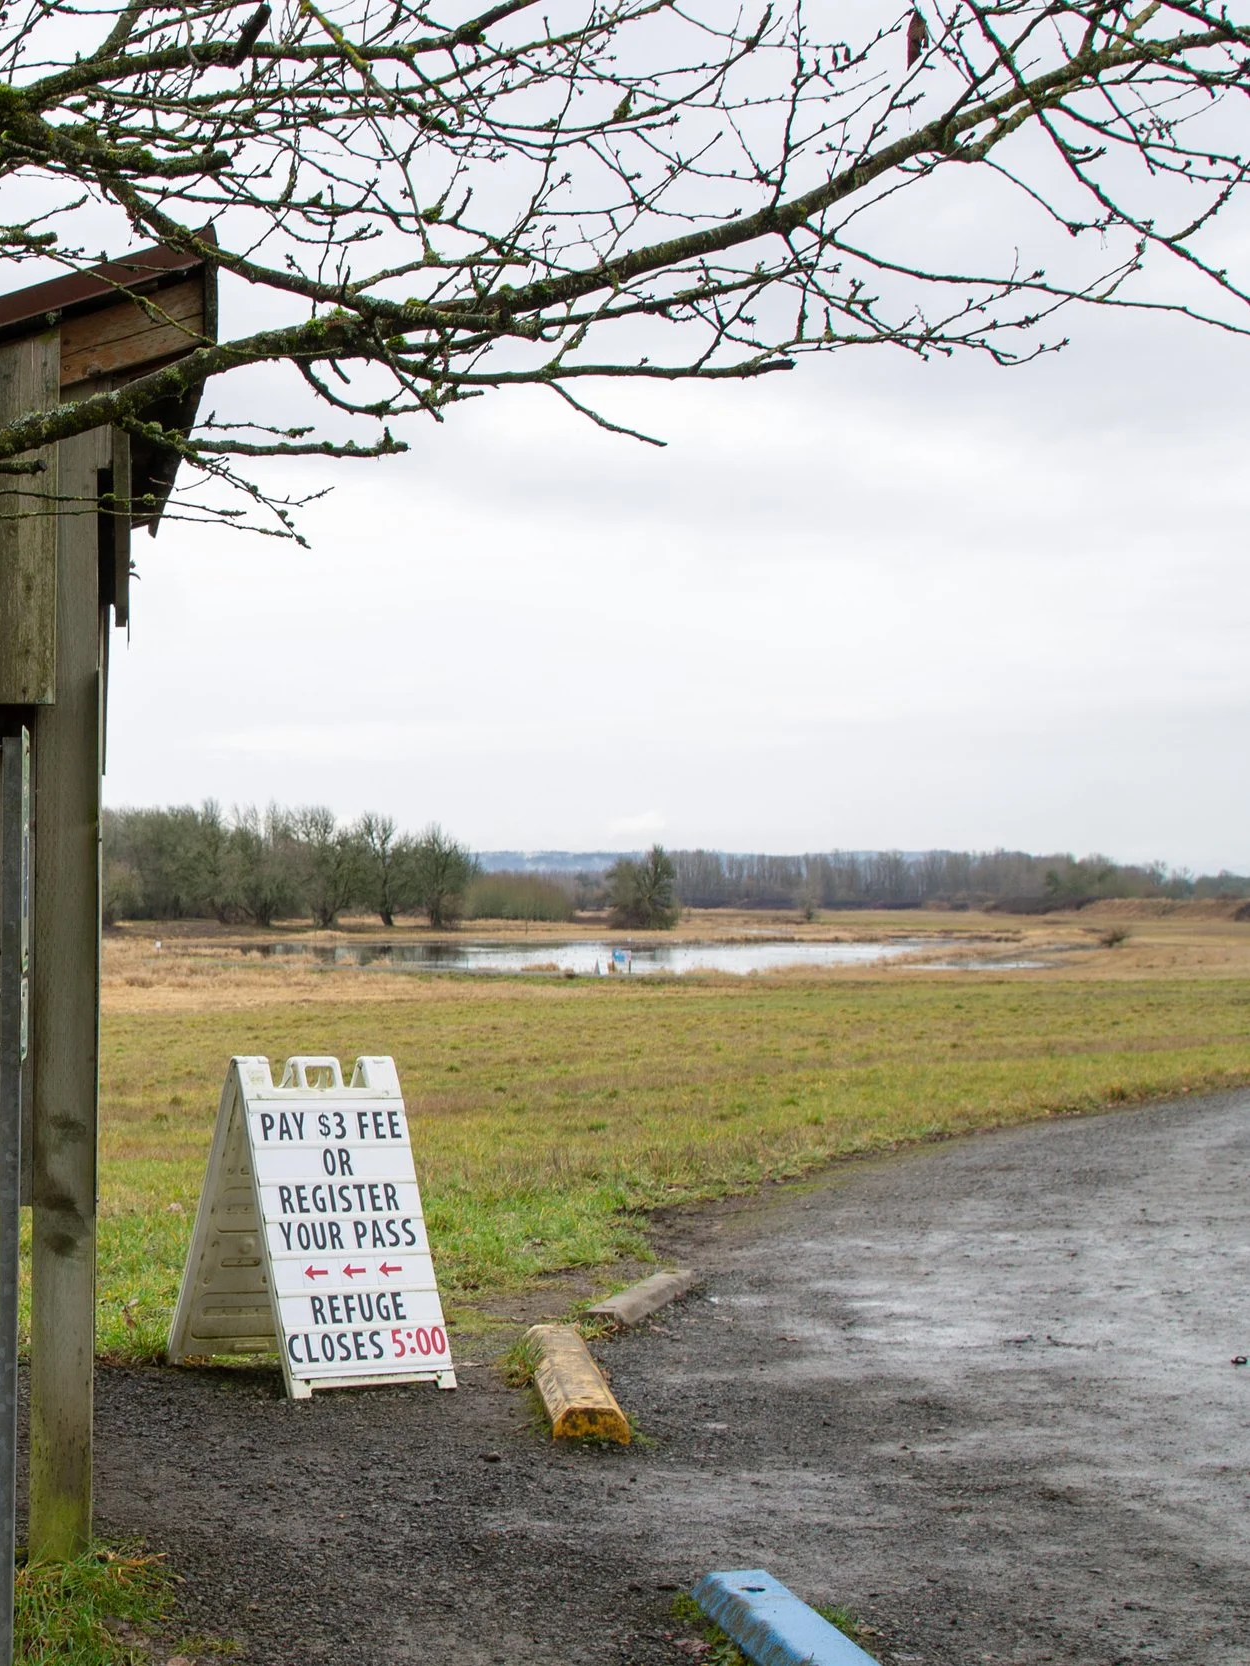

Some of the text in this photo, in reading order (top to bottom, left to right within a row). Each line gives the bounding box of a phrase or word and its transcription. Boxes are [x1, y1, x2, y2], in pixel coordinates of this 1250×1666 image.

[261, 1111, 402, 1140] PAY $3 FEE
[323, 1148, 353, 1176] OR
[279, 1183, 400, 1214] REGISTER
[279, 1219, 416, 1251] YOUR PASS
[310, 1292, 406, 1324] REFUGE
[288, 1326, 446, 1363] CLOSES 5:00
